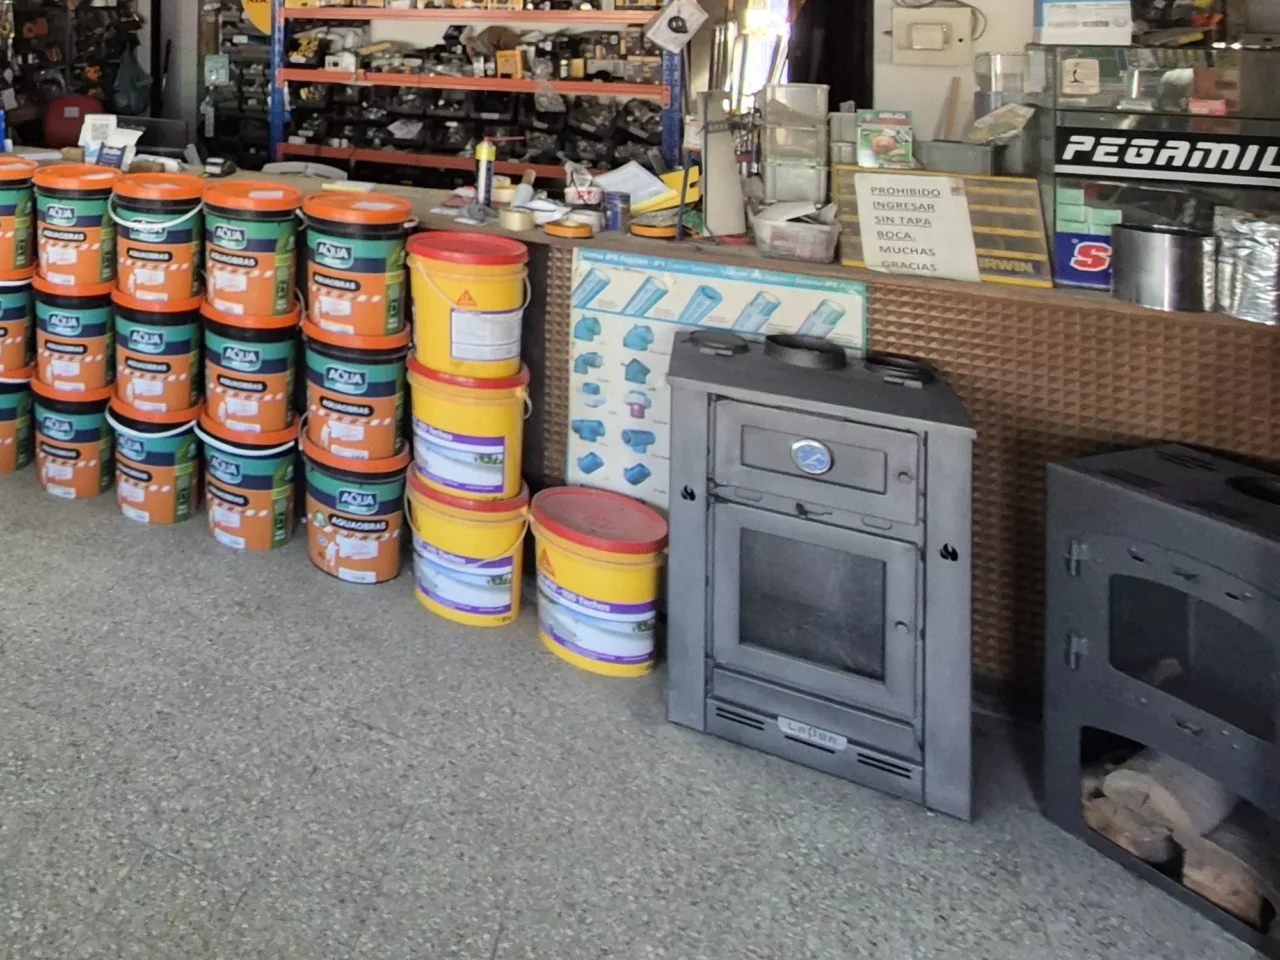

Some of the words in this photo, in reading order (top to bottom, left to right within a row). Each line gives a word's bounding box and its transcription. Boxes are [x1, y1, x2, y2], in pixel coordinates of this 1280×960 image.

[1062, 135, 1280, 172] PEGAMIL
[871, 186, 941, 197] PROHIBIDO
[872, 200, 936, 212] INGRESAR
[874, 215, 897, 225] SIN
[900, 216, 932, 227] TAPA
[215, 226, 243, 242] AQUA
[318, 243, 349, 259] AQUA
[879, 245, 936, 257] MUCHAS
[881, 260, 937, 272] GRACIAS
[132, 330, 162, 344] AQUA
[223, 347, 257, 363] AQUA
[327, 368, 363, 385] AQUA
[340, 491, 375, 506] AQUA
